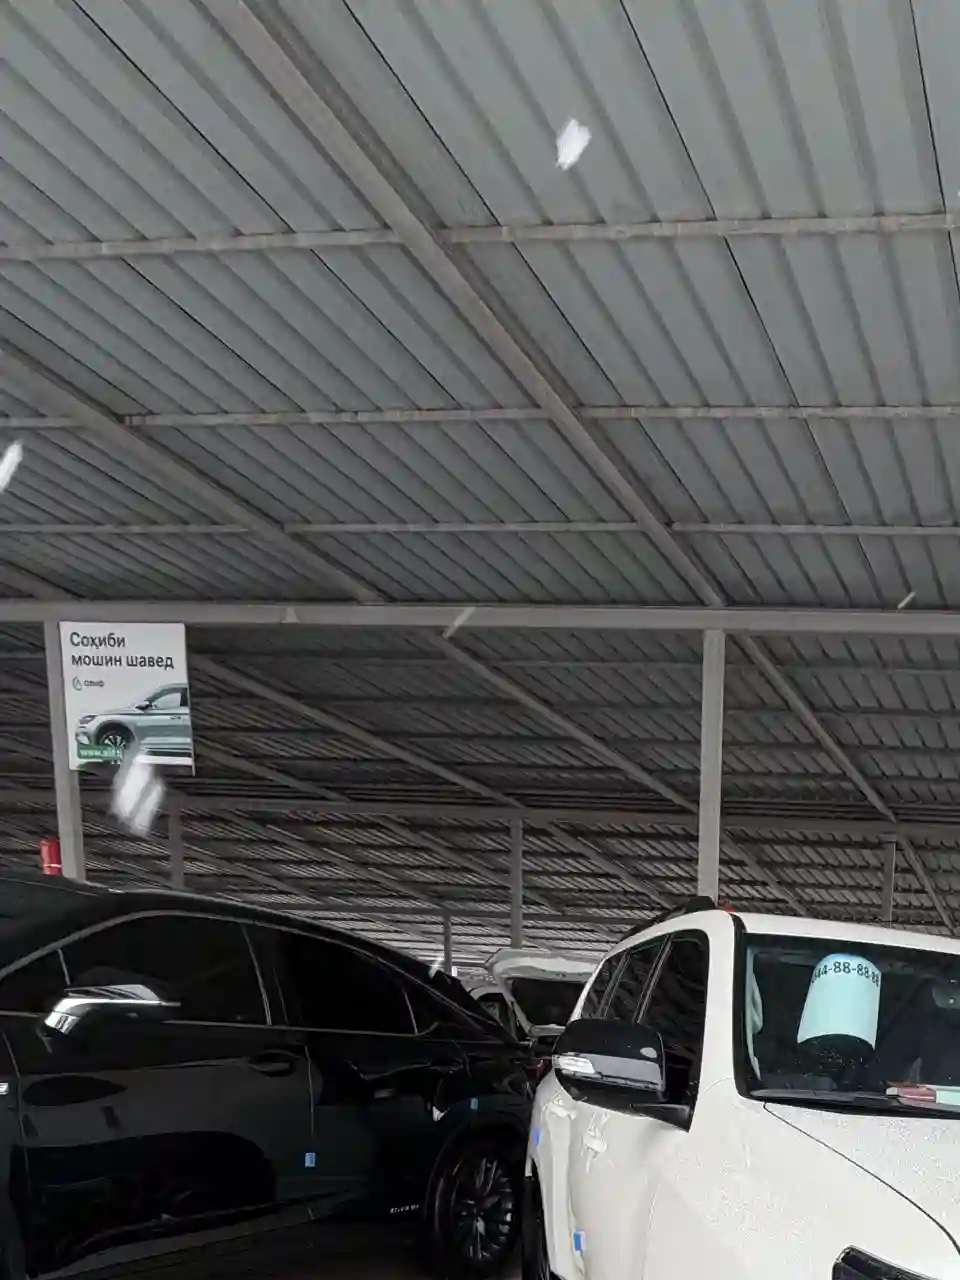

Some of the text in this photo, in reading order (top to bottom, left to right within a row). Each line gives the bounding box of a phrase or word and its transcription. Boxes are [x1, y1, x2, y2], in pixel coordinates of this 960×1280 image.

[70, 631, 126, 650] Соҳиби
[71, 654, 175, 671] мошин шавед
